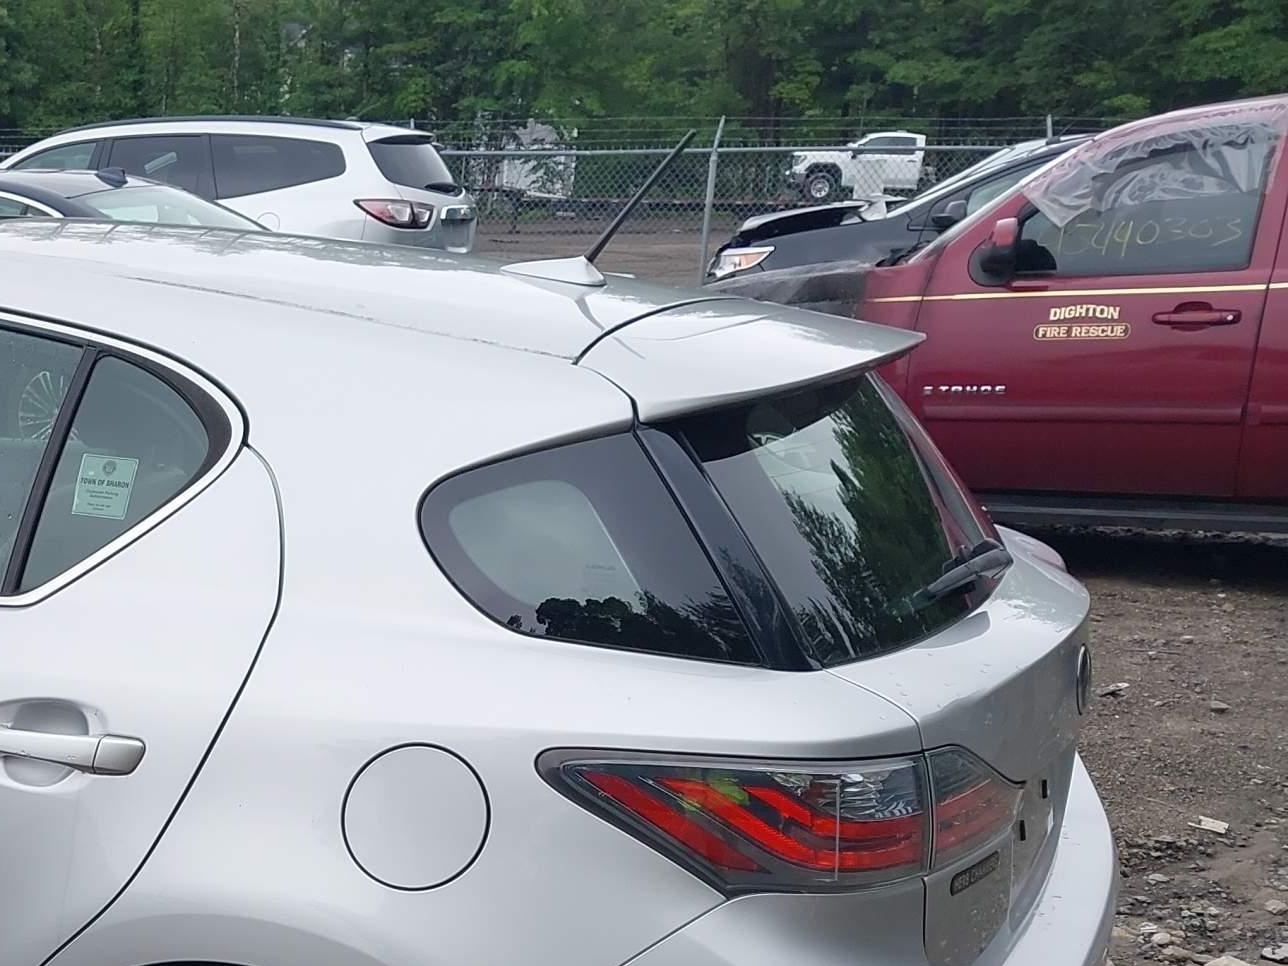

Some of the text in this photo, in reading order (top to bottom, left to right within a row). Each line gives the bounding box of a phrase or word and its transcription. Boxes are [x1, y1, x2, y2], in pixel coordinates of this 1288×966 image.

[1049, 304, 1120, 320] DIGHTON
[1038, 325, 1126, 338] FIRE RESCUE
[80, 477, 96, 486] TOWN
